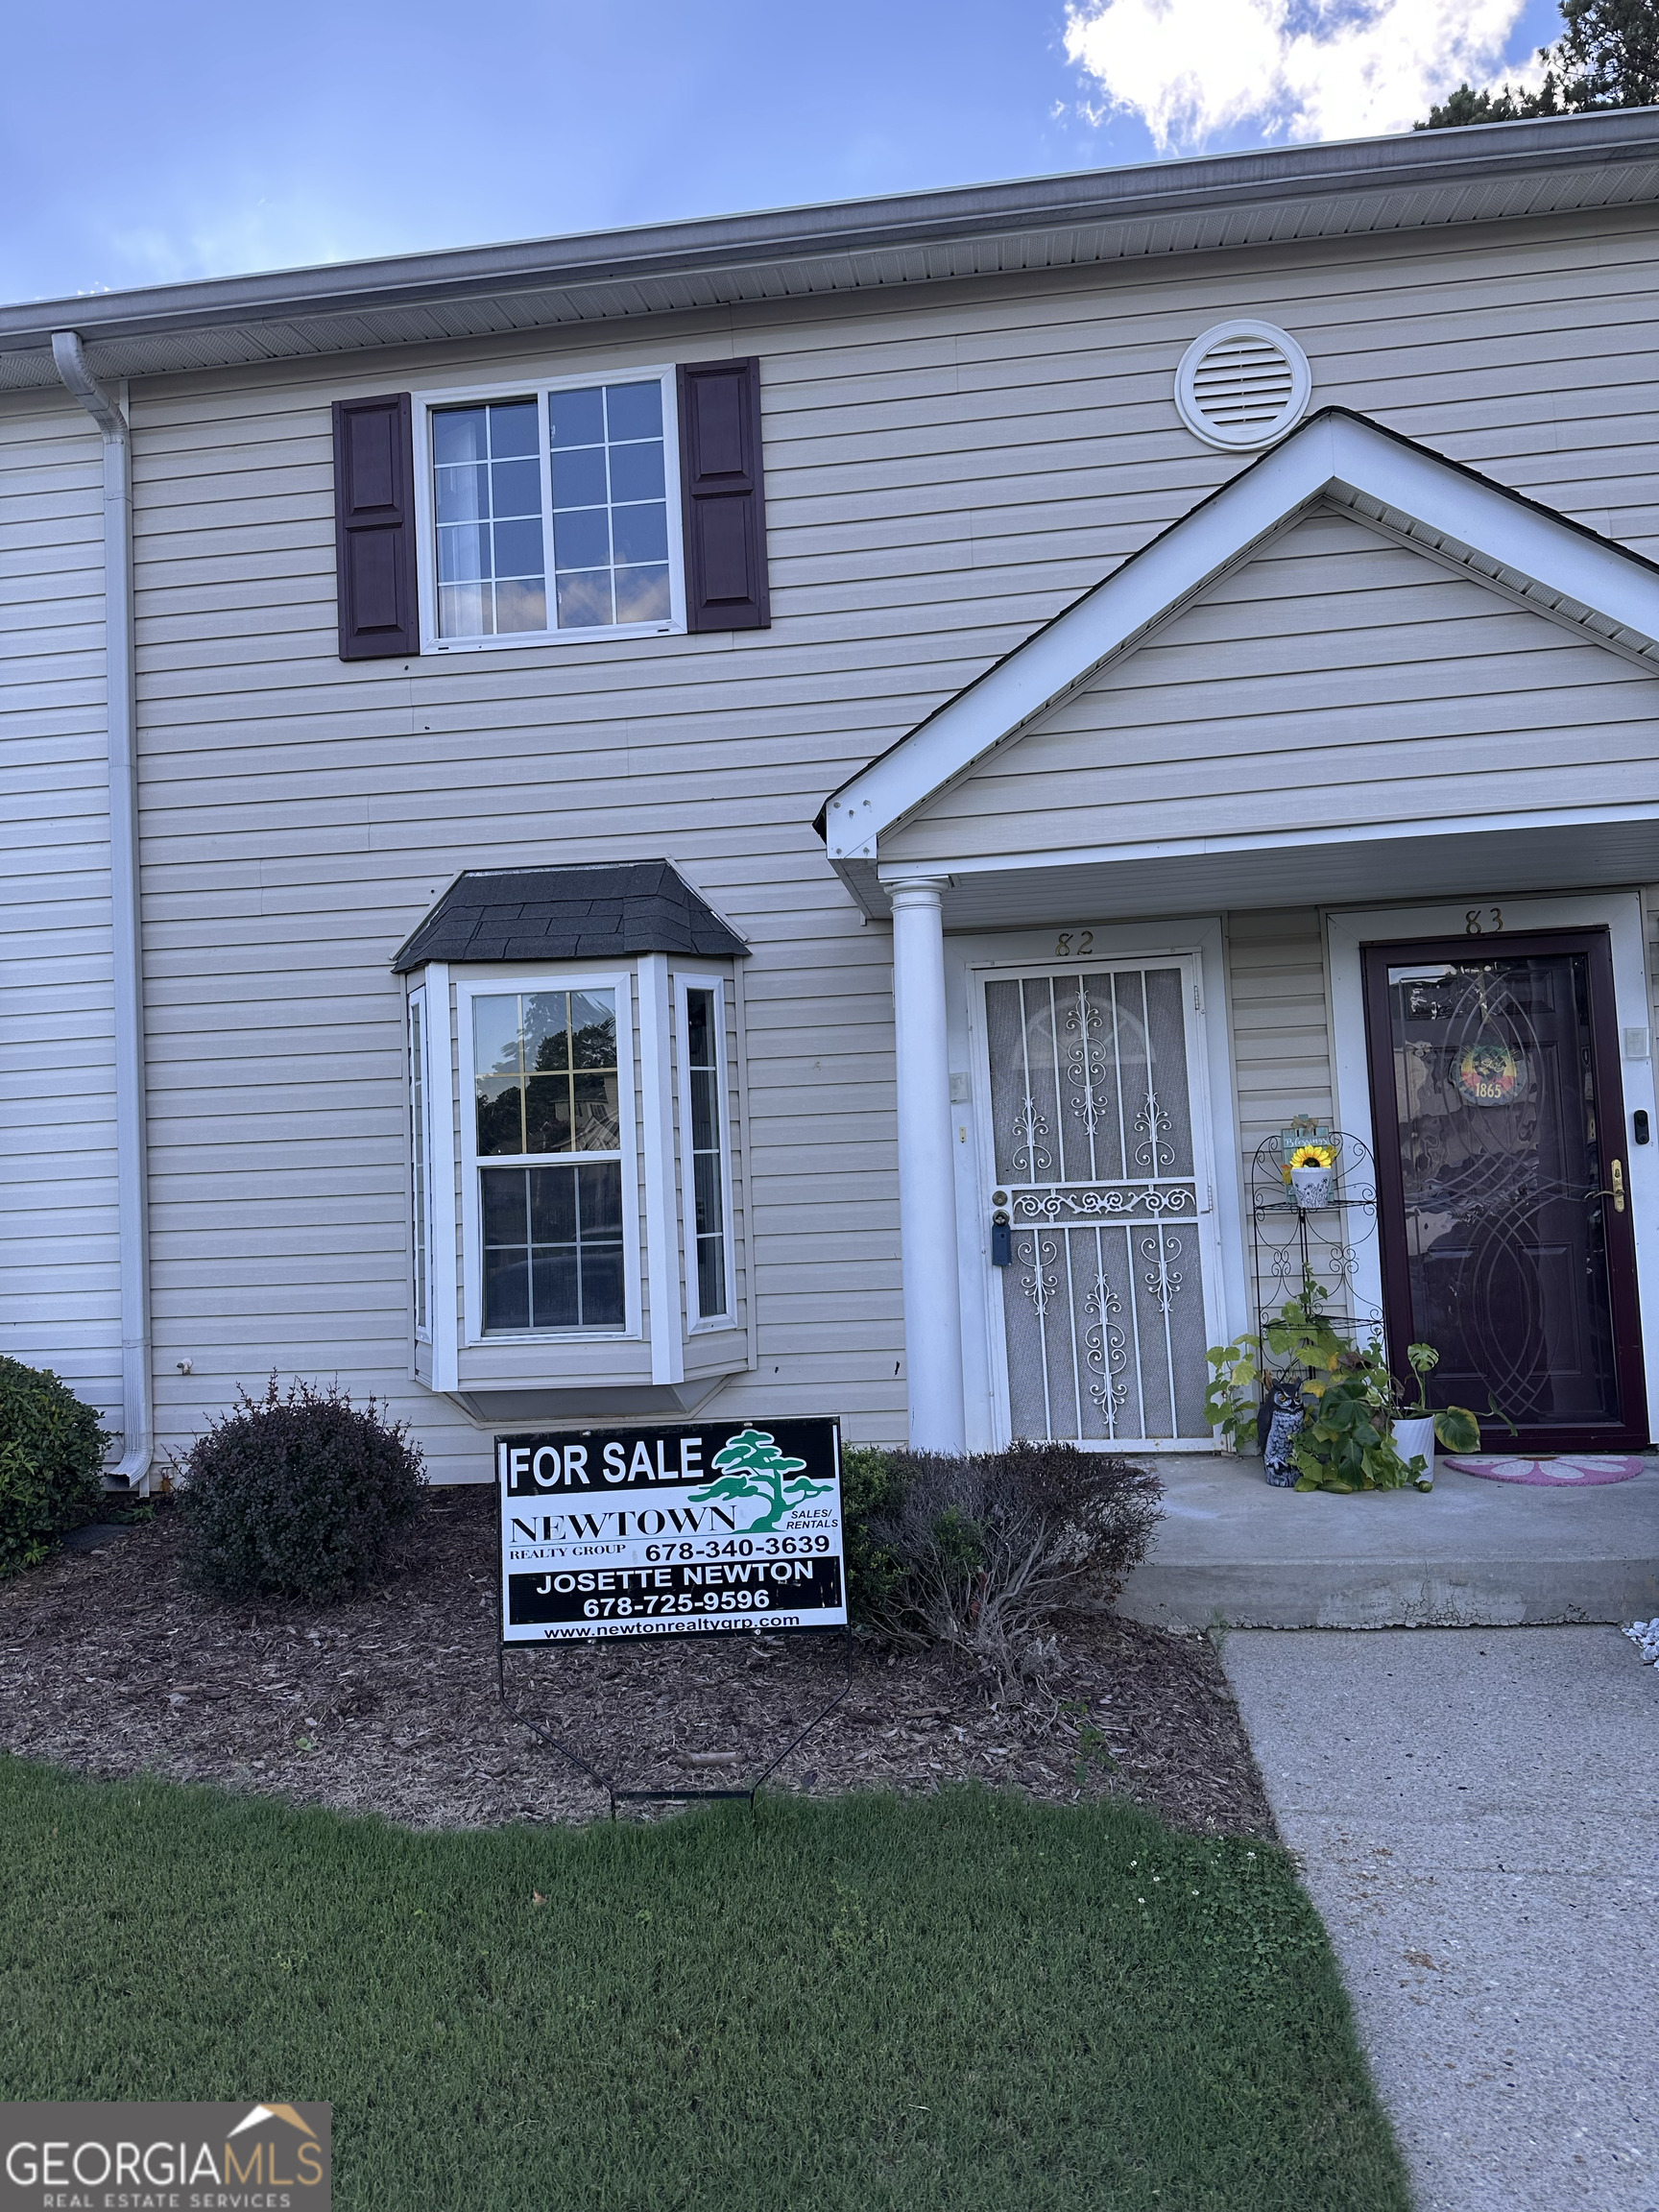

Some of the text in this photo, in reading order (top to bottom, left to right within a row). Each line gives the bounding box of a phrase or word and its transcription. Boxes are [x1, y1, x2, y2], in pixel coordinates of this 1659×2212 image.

[1466, 907, 1503, 934] 83
[1055, 930, 1094, 956] 82
[1476, 1082, 1502, 1098] 1865
[1285, 1137, 1328, 1147] Blessings
[510, 1437, 704, 1488] FOR SALE
[510, 1504, 737, 1543] NEWTOWN
[785, 1519, 839, 1530] RENTALS
[790, 1508, 832, 1520] SALES/
[509, 1544, 626, 1560] REALTY GROUP
[645, 1535, 830, 1562] 678-340-3639
[536, 1560, 814, 1596] JOSETTE NEWTON
[583, 1589, 771, 1619] 678-725-9596
[543, 1615, 801, 1639] www.newtonrealtygrp.com
